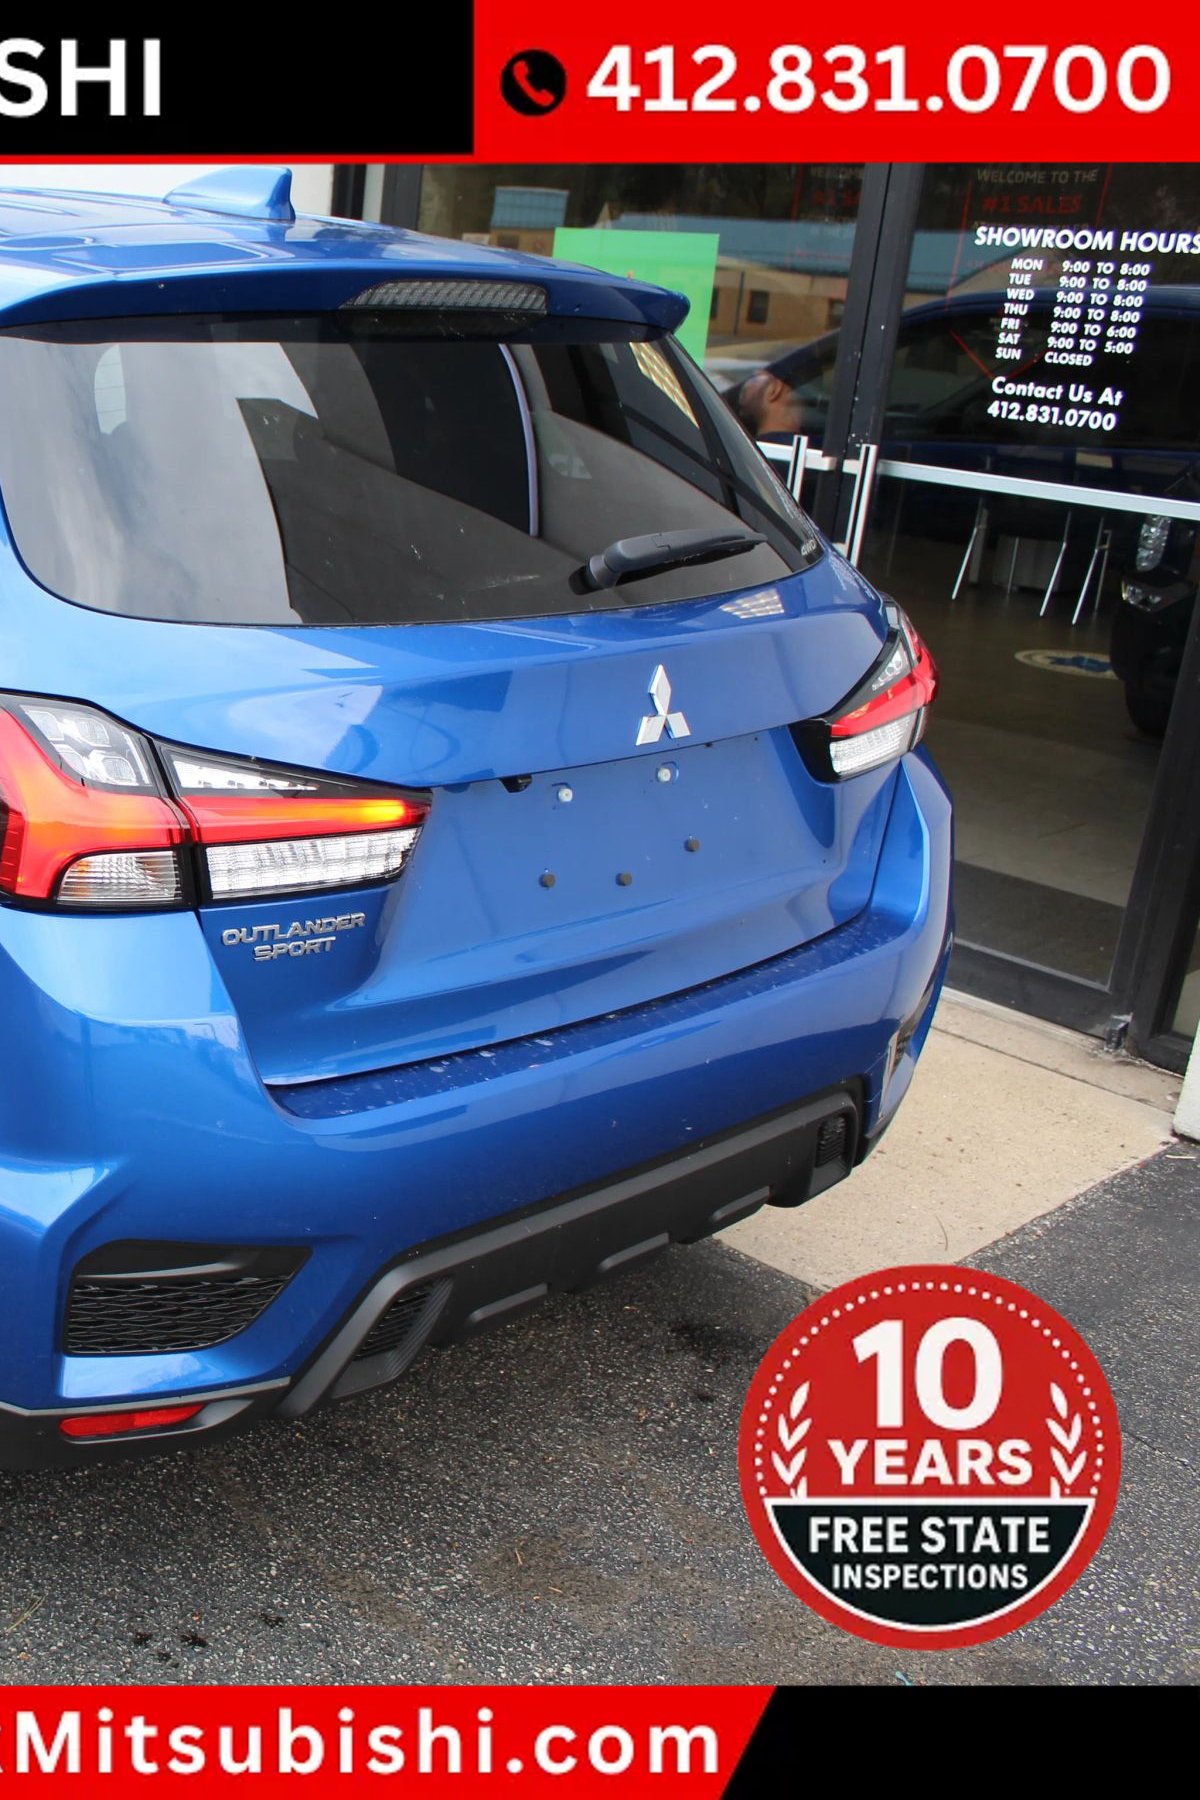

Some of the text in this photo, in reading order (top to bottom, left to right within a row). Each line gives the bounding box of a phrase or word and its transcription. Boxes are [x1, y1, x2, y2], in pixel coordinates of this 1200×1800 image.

[977, 169, 1099, 184] WELCOME TO THE
[974, 226, 1200, 255] SHOWROOM HOURS
[1011, 258, 1150, 276] MON 9:00 TO 8:00
[1009, 273, 1147, 292] TUE 9:00 TO 8:00
[1007, 288, 1143, 308] WED 9:00 TO 8:00
[1004, 303, 1140, 323] THU 9:00 TO 8:00
[1001, 318, 1137, 339] FRI 9:00 TO 6:00
[998, 332, 1133, 354] SAT 9:00 TO 5:00
[995, 347, 1093, 366] SUN CLOSED
[992, 376, 1123, 406] Contact Us At
[987, 400, 1117, 431] 412.831.0700
[222, 912, 366, 946] OUTLANDER
[253, 936, 337, 962] SPORT
